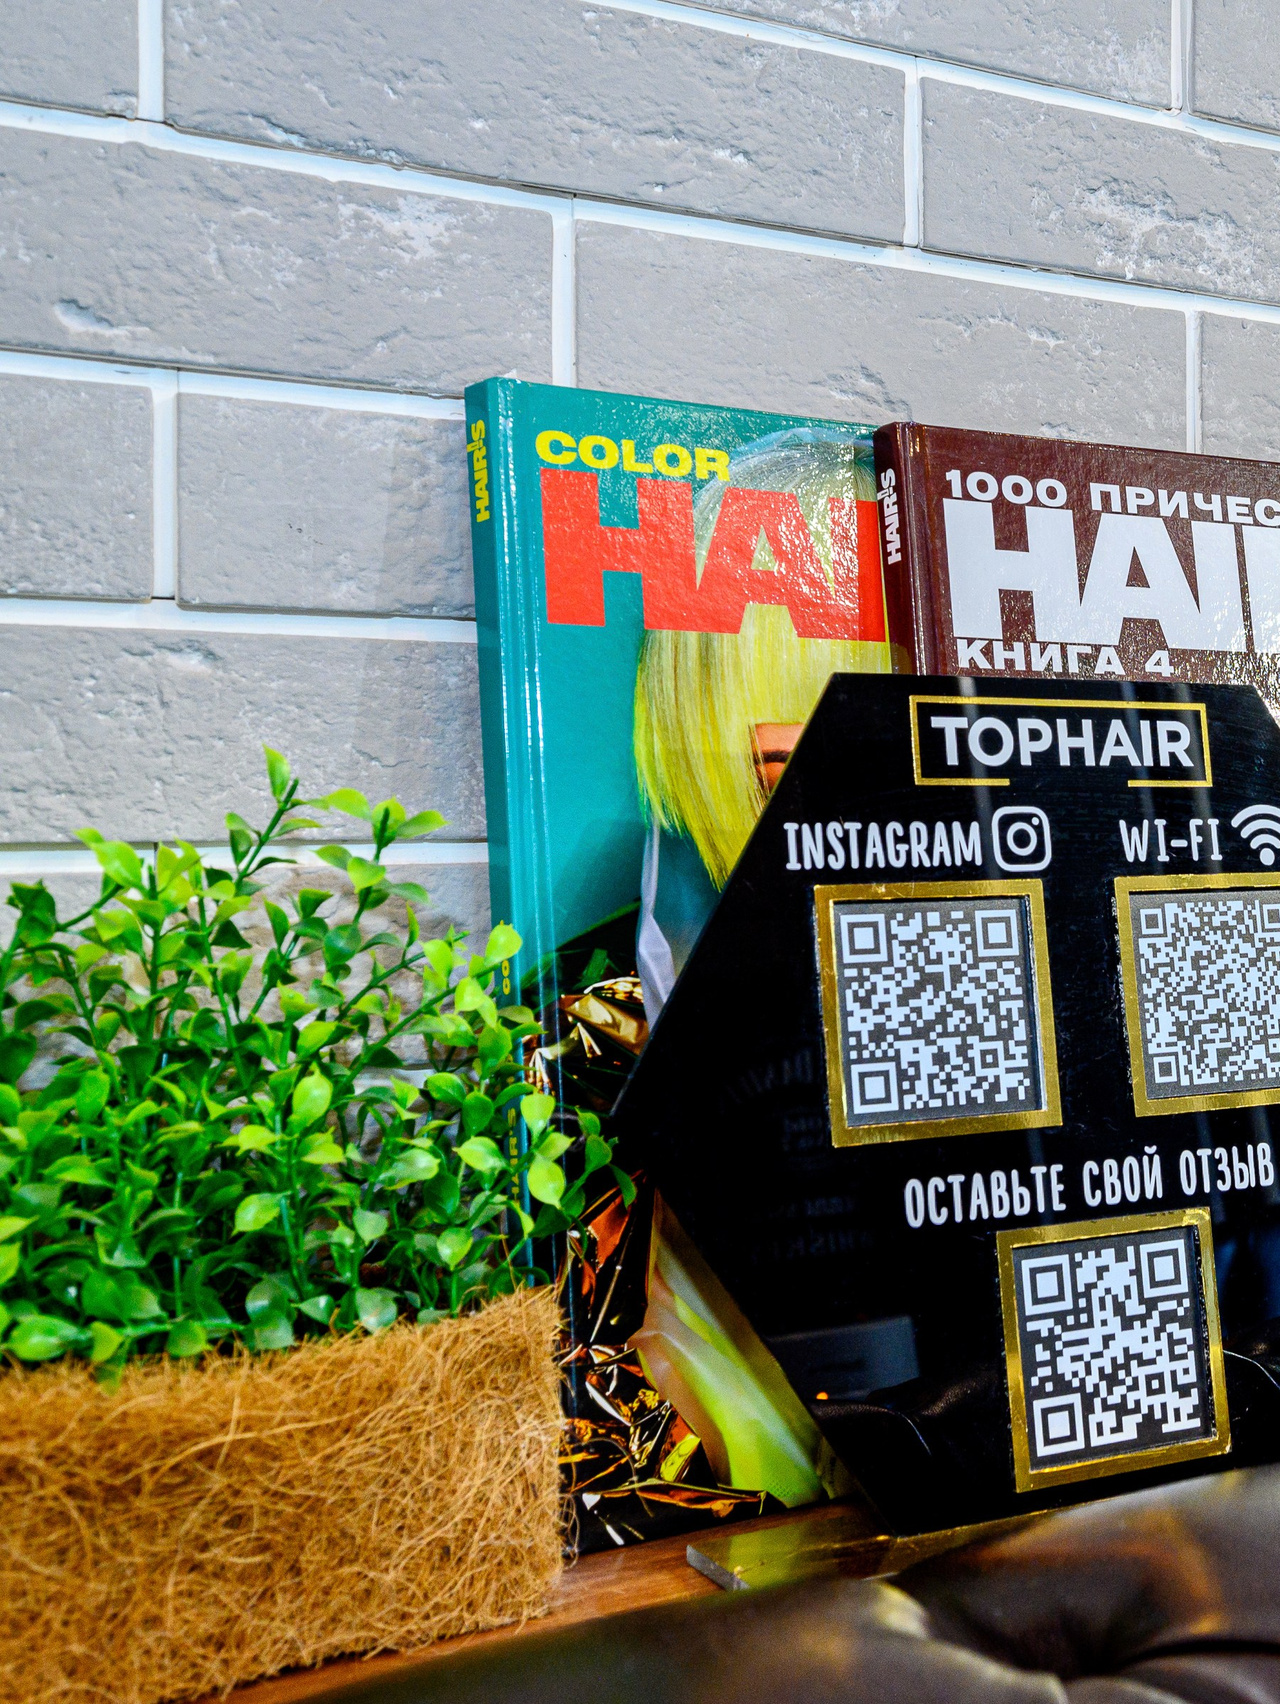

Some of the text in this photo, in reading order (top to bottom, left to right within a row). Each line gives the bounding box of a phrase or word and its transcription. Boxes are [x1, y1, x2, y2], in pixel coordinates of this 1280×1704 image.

[535, 430, 731, 482] COLOR
[945, 469, 1067, 507] 1000
[540, 467, 887, 643] HAI
[956, 638, 1174, 677] КНИГА 4
[931, 716, 1195, 768] TOPHAIR
[783, 820, 983, 870] INSTAGRAM
[1119, 817, 1223, 863] WI-FI
[904, 1143, 1275, 1228] ОСТАВЬТЕ СВОЙ ОТЗЫВ
